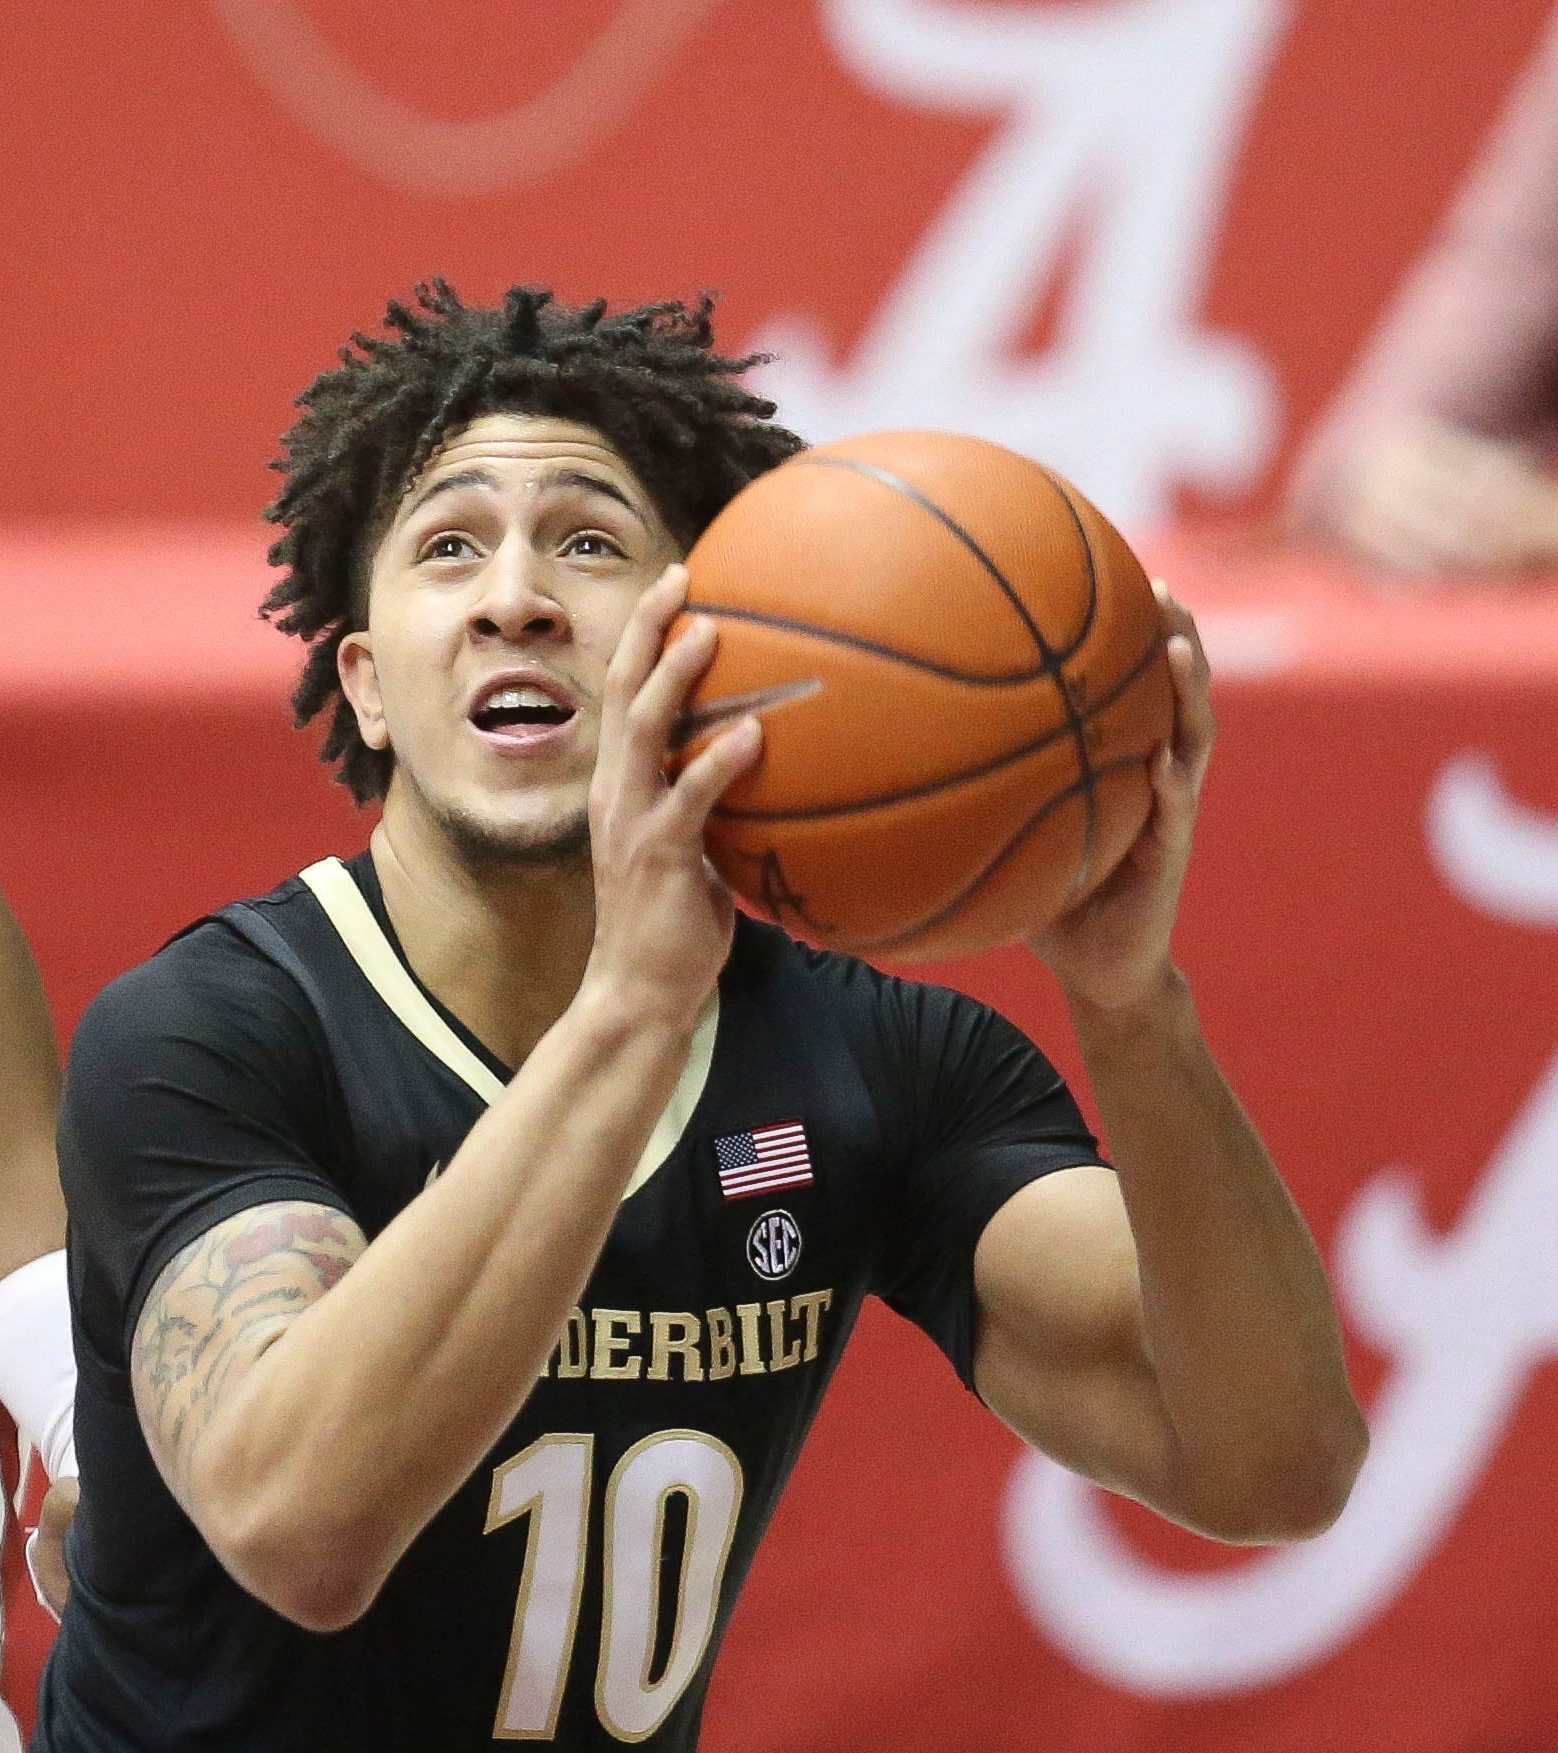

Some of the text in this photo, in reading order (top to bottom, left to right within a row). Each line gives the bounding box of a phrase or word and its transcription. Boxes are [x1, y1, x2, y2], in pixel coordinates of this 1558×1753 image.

[750, 1213, 800, 1277] SEC
[540, 1288, 834, 1382] DERBILT
[483, 1428, 744, 1743] 10
